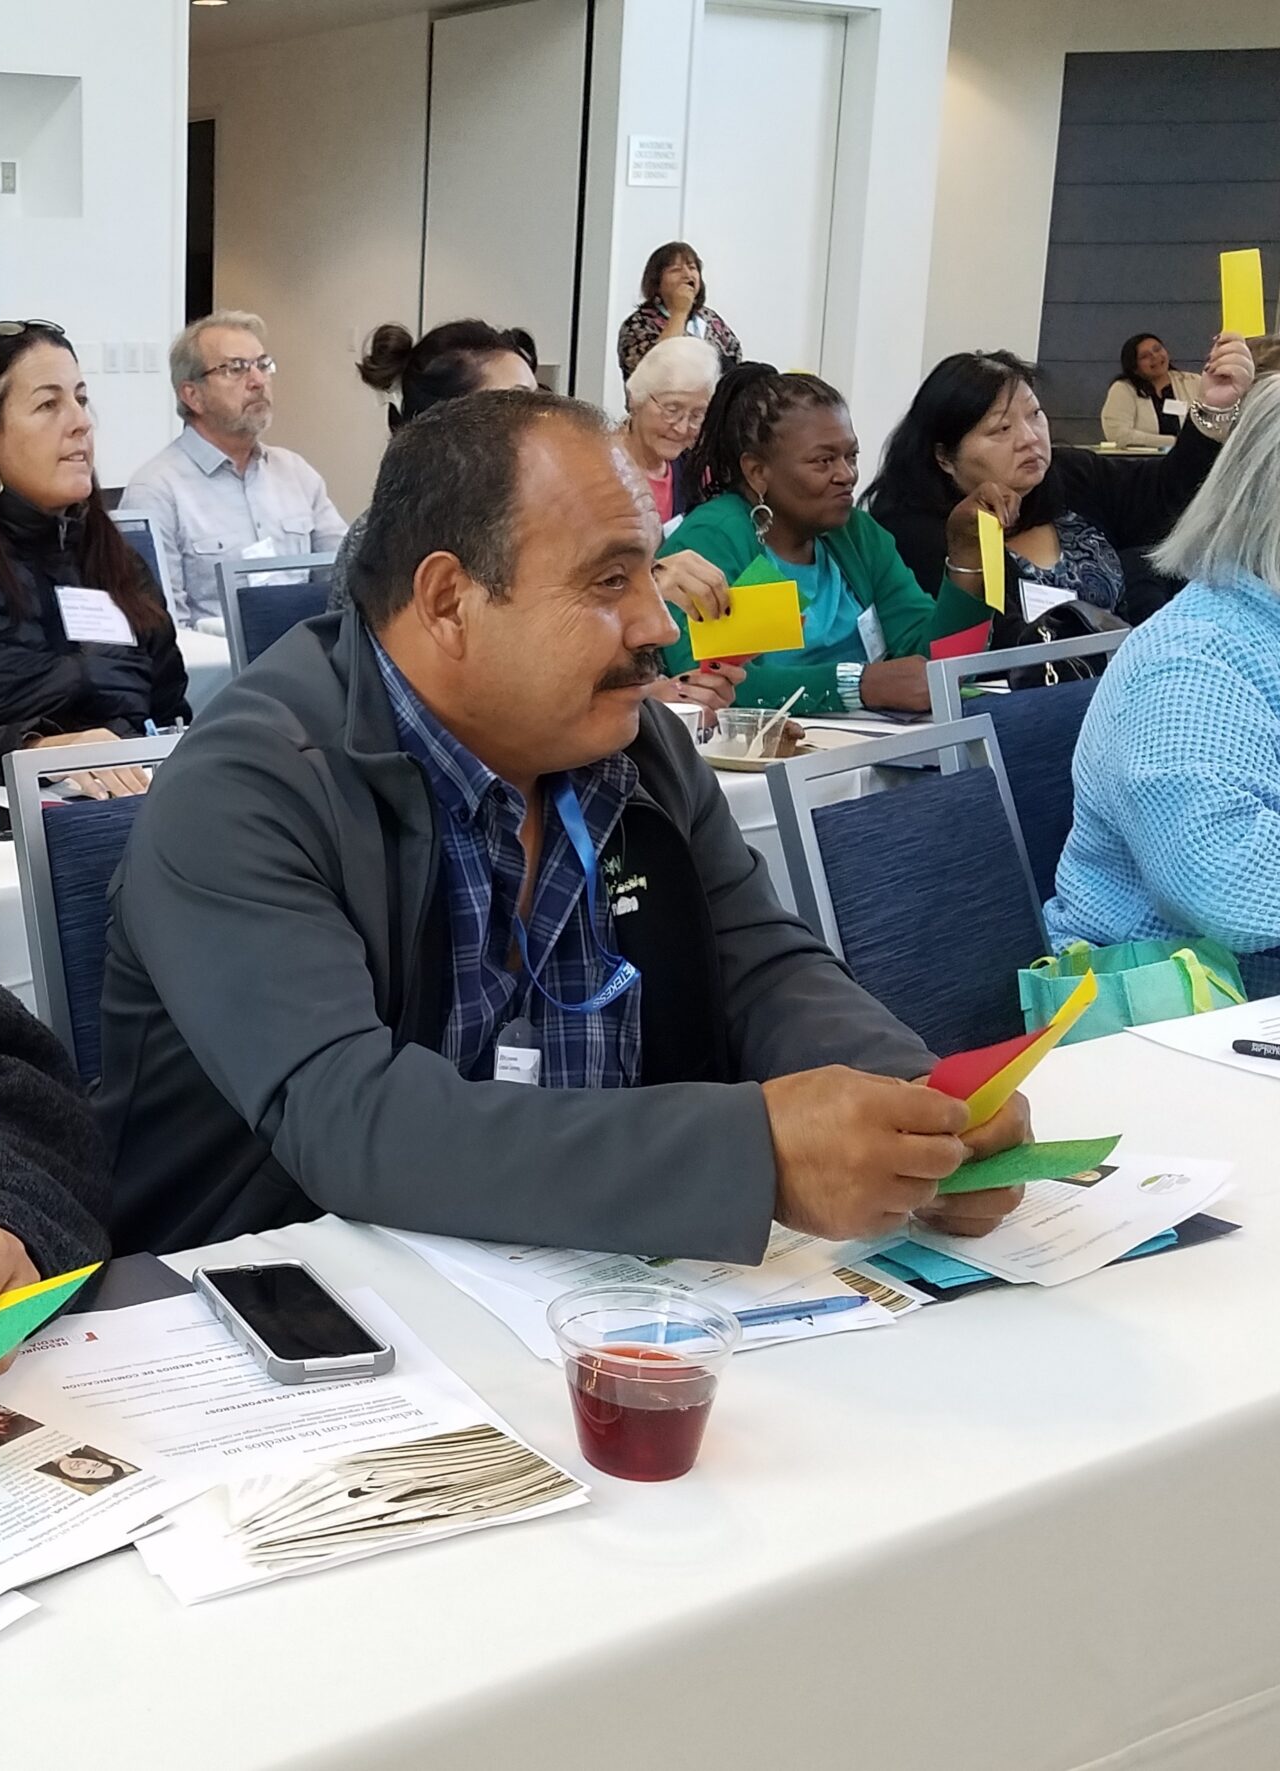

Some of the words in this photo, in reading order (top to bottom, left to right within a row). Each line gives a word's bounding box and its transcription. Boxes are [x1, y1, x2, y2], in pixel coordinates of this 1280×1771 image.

[16, 1341, 69, 1355] RESOURC
[155, 1361, 192, 1373] MEDIOS
[193, 1357, 213, 1365] LOS
[297, 1381, 350, 1397] NECESITAN
[275, 1392, 295, 1400] LOS
[203, 1396, 273, 1415] REPORTEROS?
[349, 1407, 423, 1430] Relaciones
[297, 1428, 319, 1440] los
[320, 1422, 347, 1435] con
[244, 1433, 296, 1452] medios
